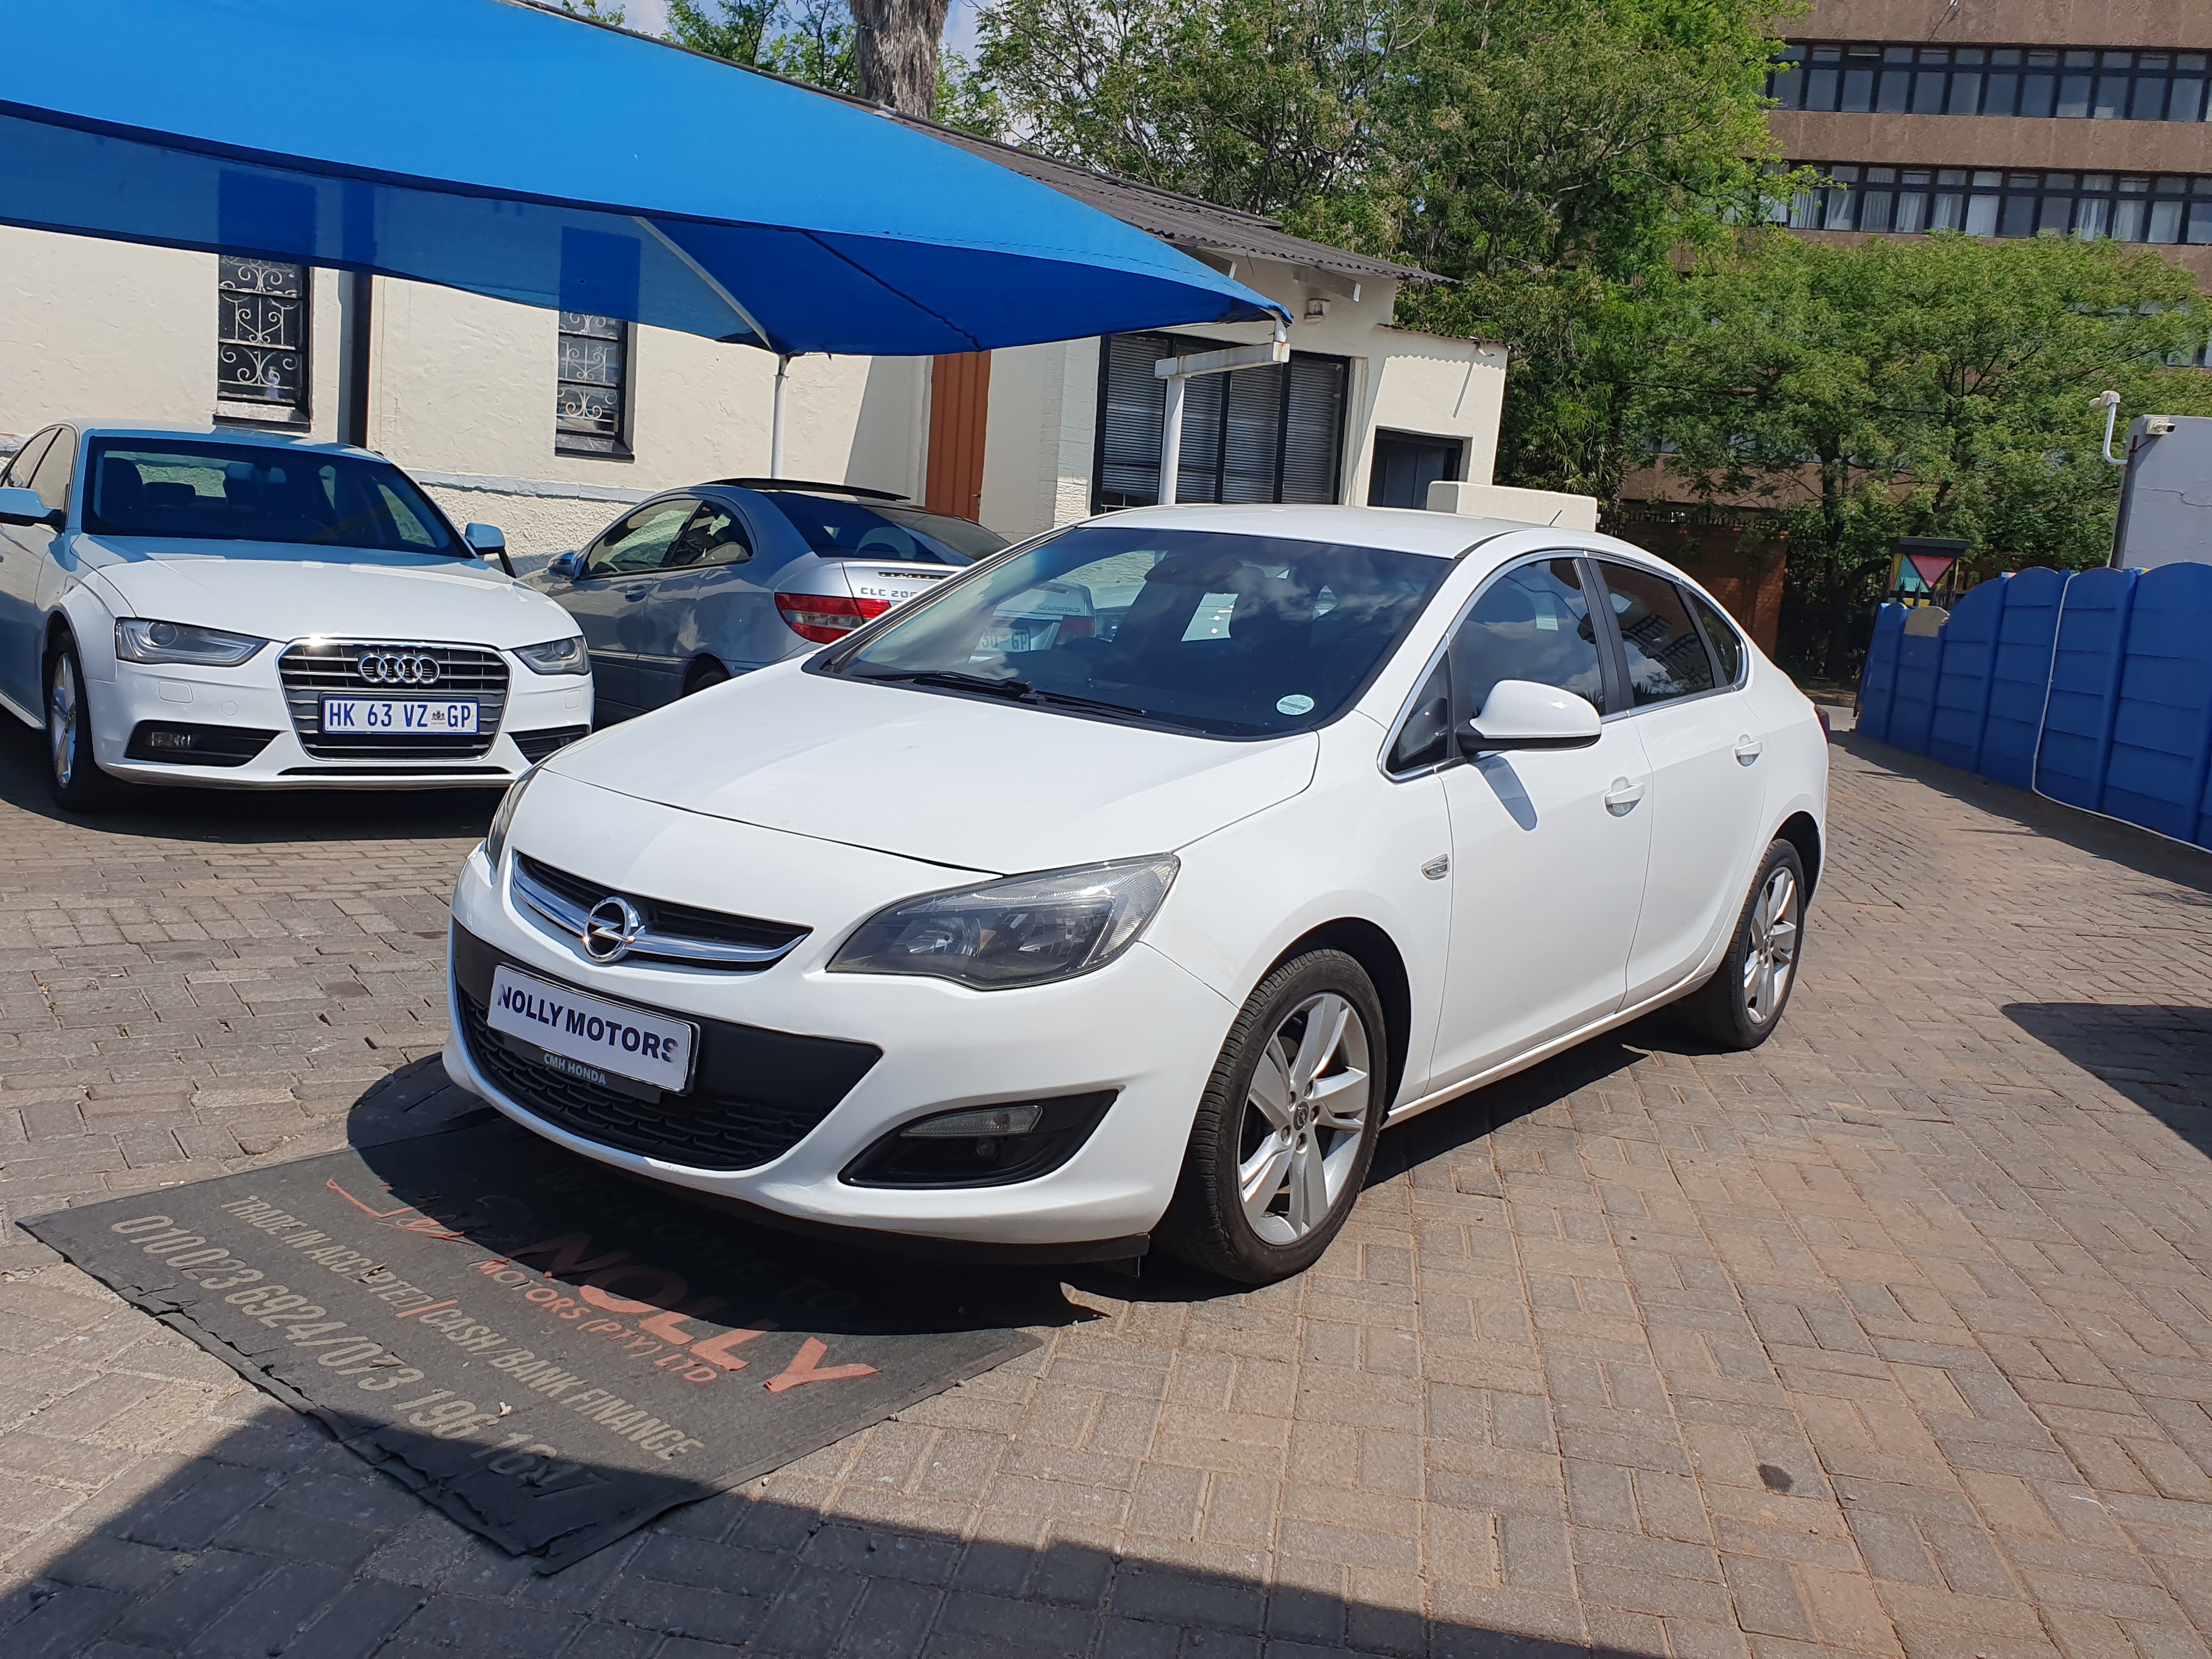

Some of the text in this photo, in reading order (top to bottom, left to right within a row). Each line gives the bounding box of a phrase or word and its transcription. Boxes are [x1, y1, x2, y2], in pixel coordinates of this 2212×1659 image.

[861, 587, 886, 596] CLC
[330, 703, 471, 728] HK 63 VZ GP
[497, 984, 679, 1063] NOLLY MOTORS
[544, 1053, 606, 1085] CMH HONDA
[221, 1195, 308, 1235] TRADE
[280, 1229, 332, 1249] IN
[560, 1388, 704, 1461] FINANCE
[505, 1231, 881, 1392] NOLLY
[577, 1318, 663, 1358] (PTY)
[654, 1353, 717, 1382] LTD
[392, 1388, 500, 1440] 196
